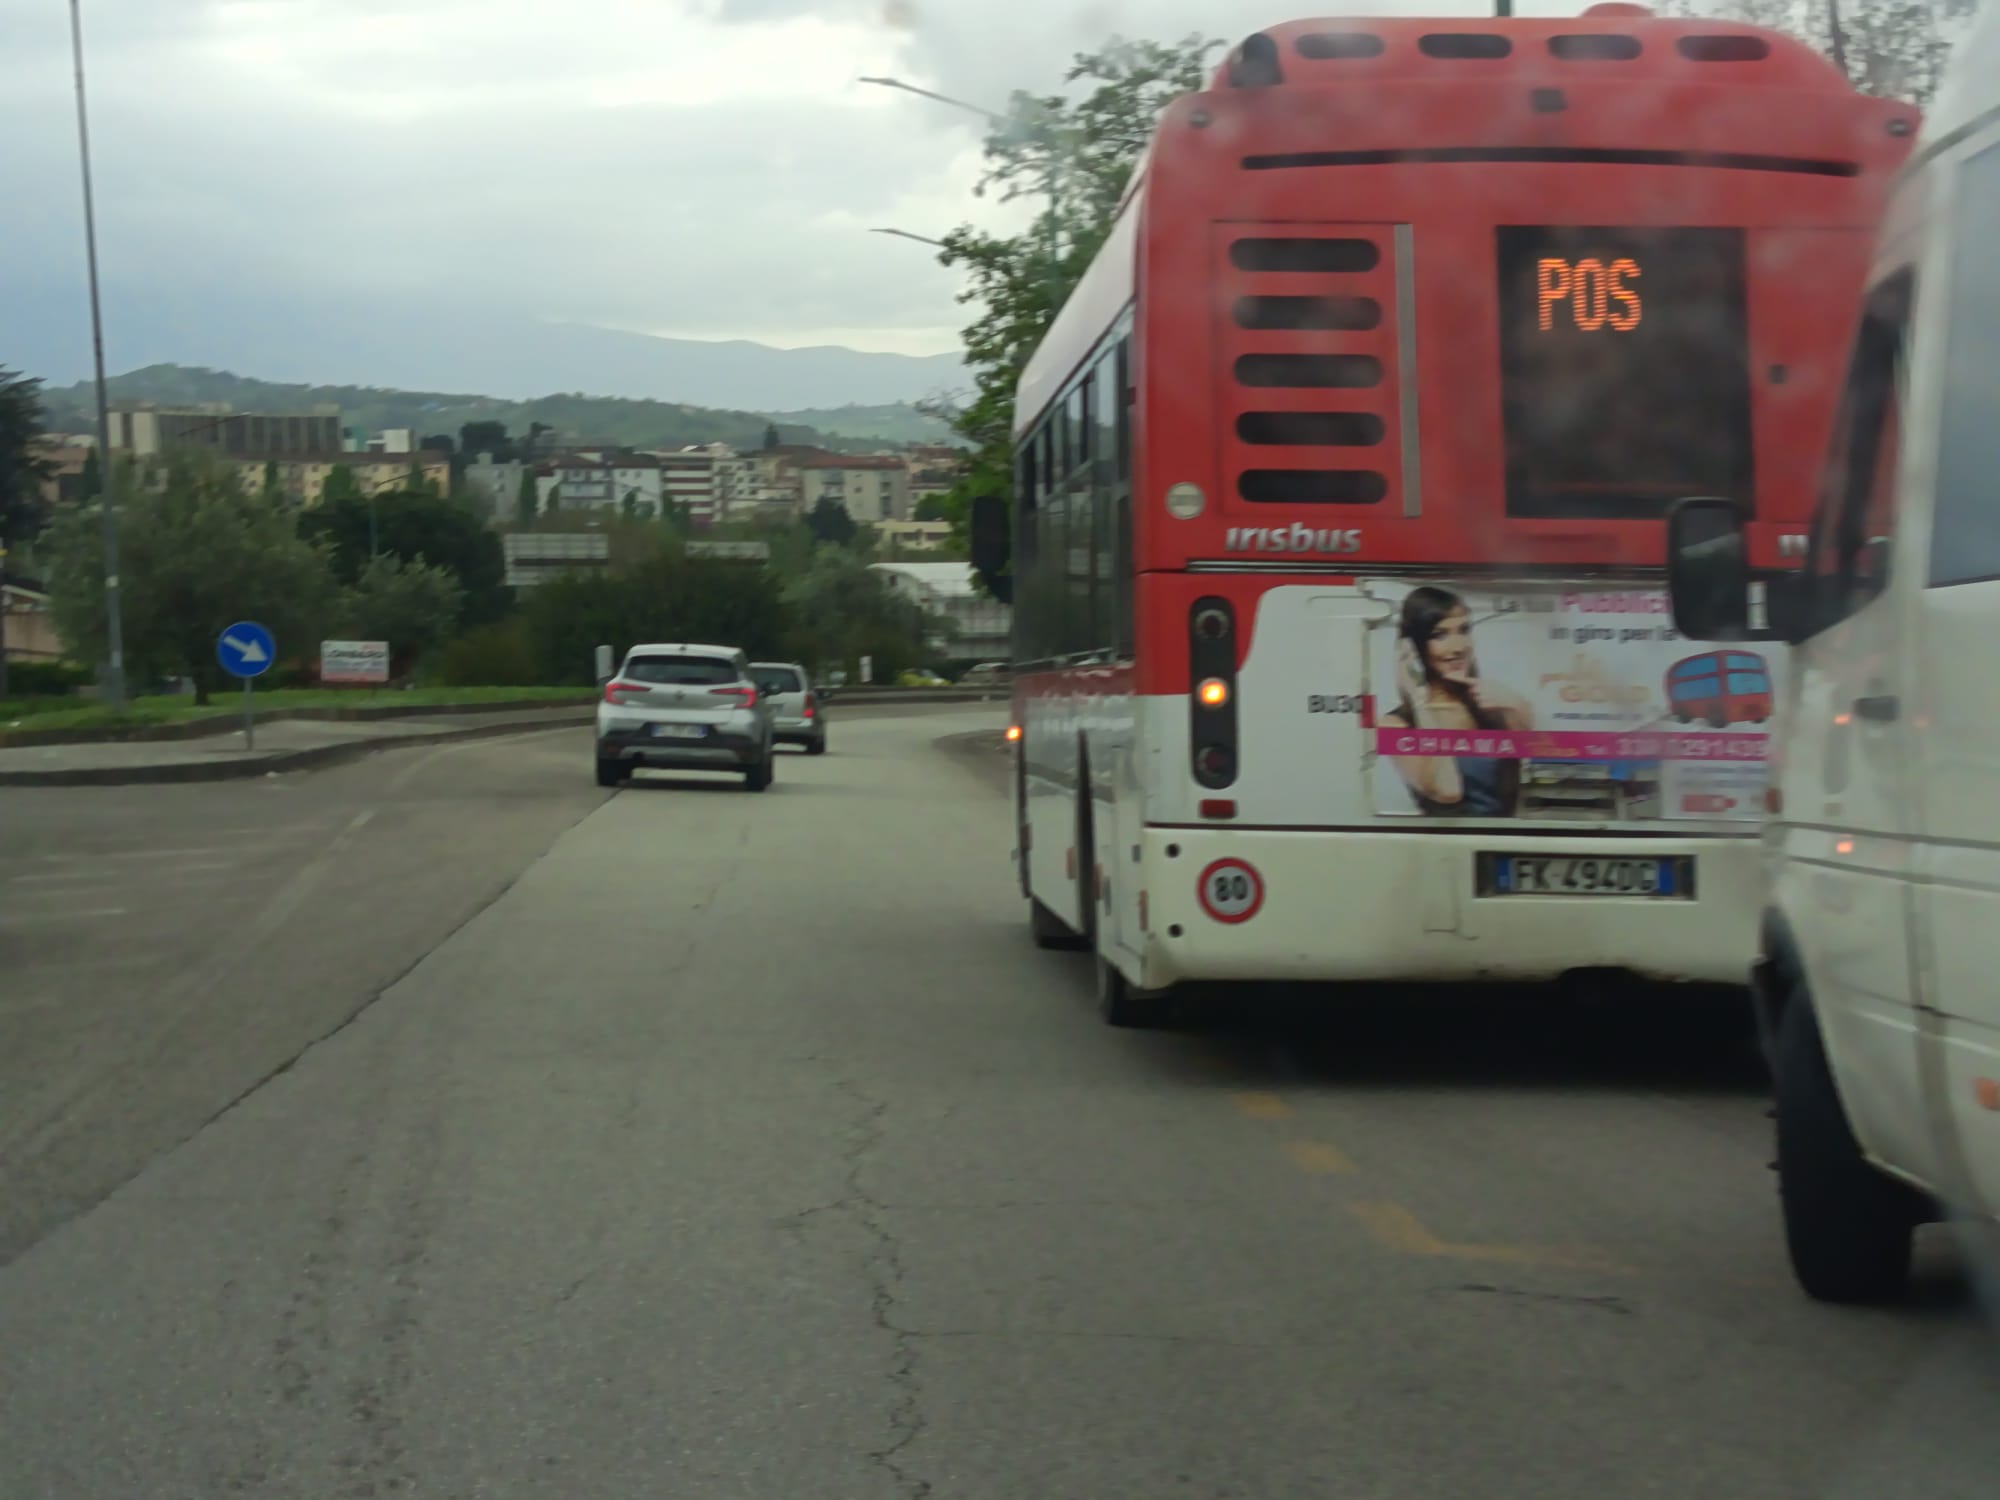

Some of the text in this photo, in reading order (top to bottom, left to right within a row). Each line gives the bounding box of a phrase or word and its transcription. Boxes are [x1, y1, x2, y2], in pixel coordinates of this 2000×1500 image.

[1538, 257, 1642, 332] POS
[1225, 521, 1363, 553] irisbus
[1395, 736, 1517, 755] CHIAMA
[1214, 874, 1249, 903] 80
